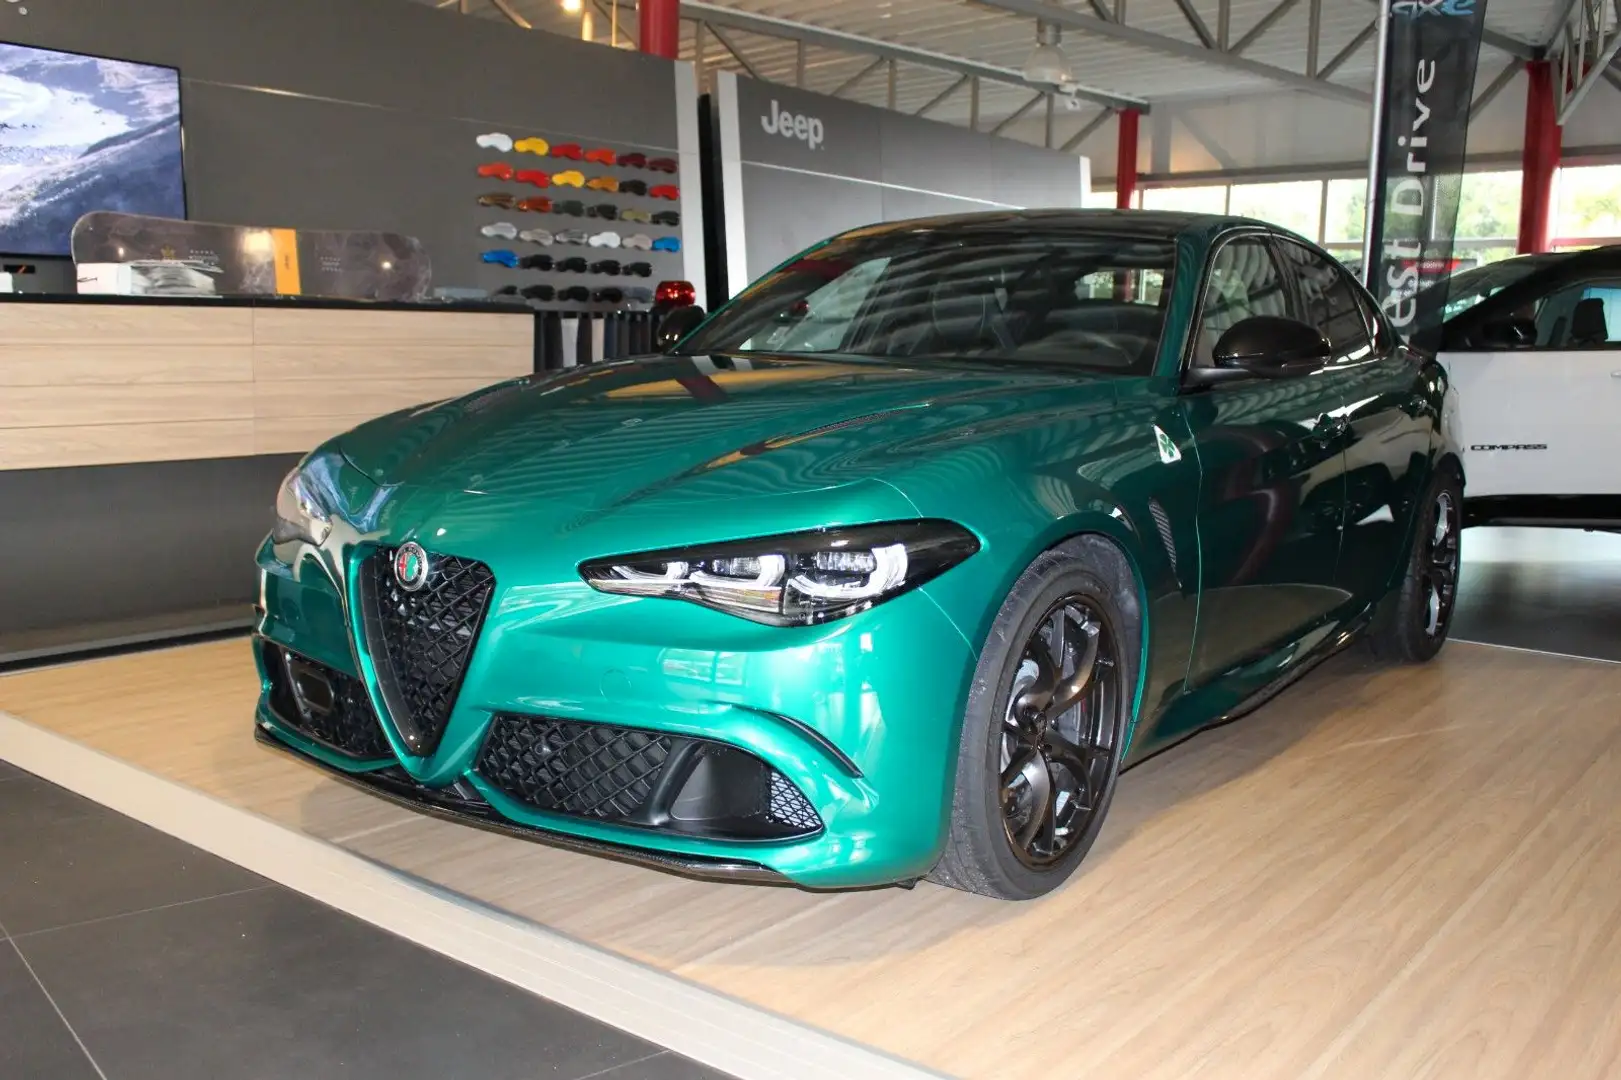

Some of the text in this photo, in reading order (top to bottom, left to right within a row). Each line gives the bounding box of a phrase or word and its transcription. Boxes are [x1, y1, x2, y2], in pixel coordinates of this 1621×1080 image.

[760, 99, 824, 150] Jeep
[1390, 58, 1436, 217] Drive
[1382, 239, 1422, 345] est
[1470, 443, 1548, 451] COMPASS
